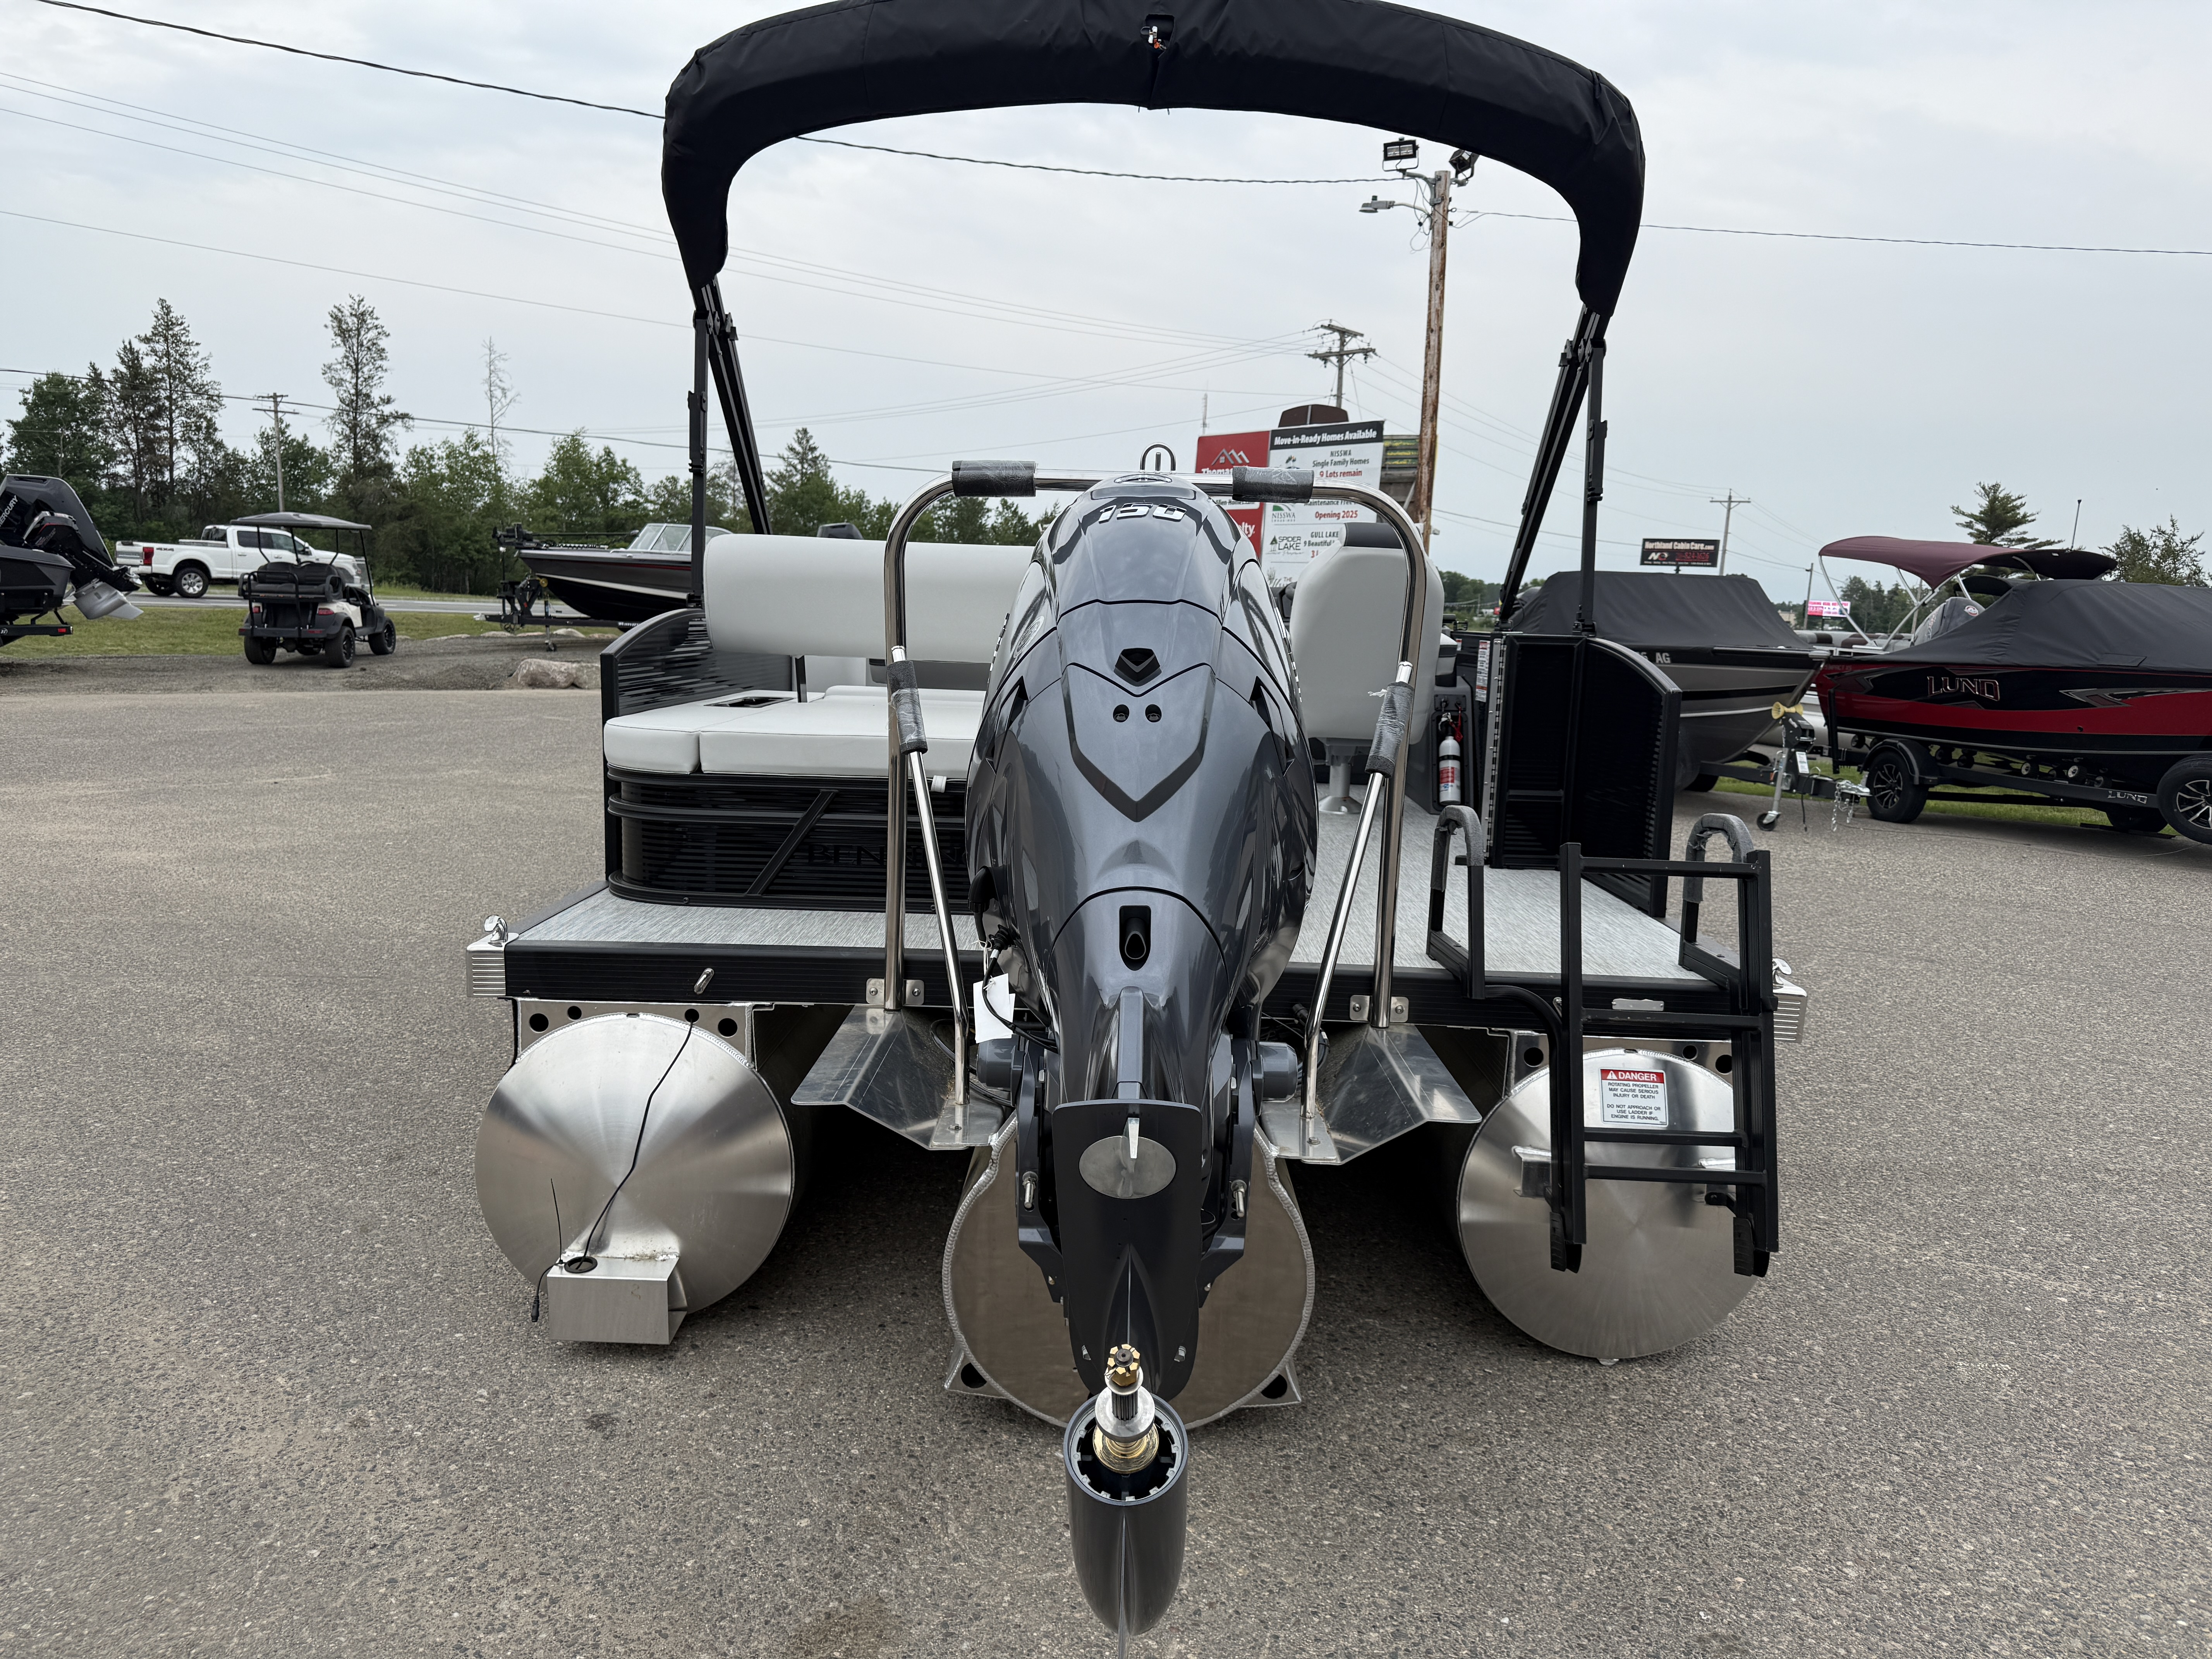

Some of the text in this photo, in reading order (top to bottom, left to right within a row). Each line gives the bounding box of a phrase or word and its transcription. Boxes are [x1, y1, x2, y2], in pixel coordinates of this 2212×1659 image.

[1274, 429, 1377, 445] Move-in-Ready Homes Available
[1312, 460, 1329, 469] Single
[1331, 459, 1349, 467] Family
[1340, 469, 1362, 477] remain
[1098, 502, 1187, 524] 150
[1315, 510, 1358, 520] Opening 2025
[1645, 541, 1673, 549] Northland
[1673, 541, 1690, 550] Cabin
[1656, 652, 1671, 663] AG
[1927, 676, 2000, 701] LUND
[2107, 790, 2147, 804] LUND
[1618, 1072, 1657, 1081] DANGER
